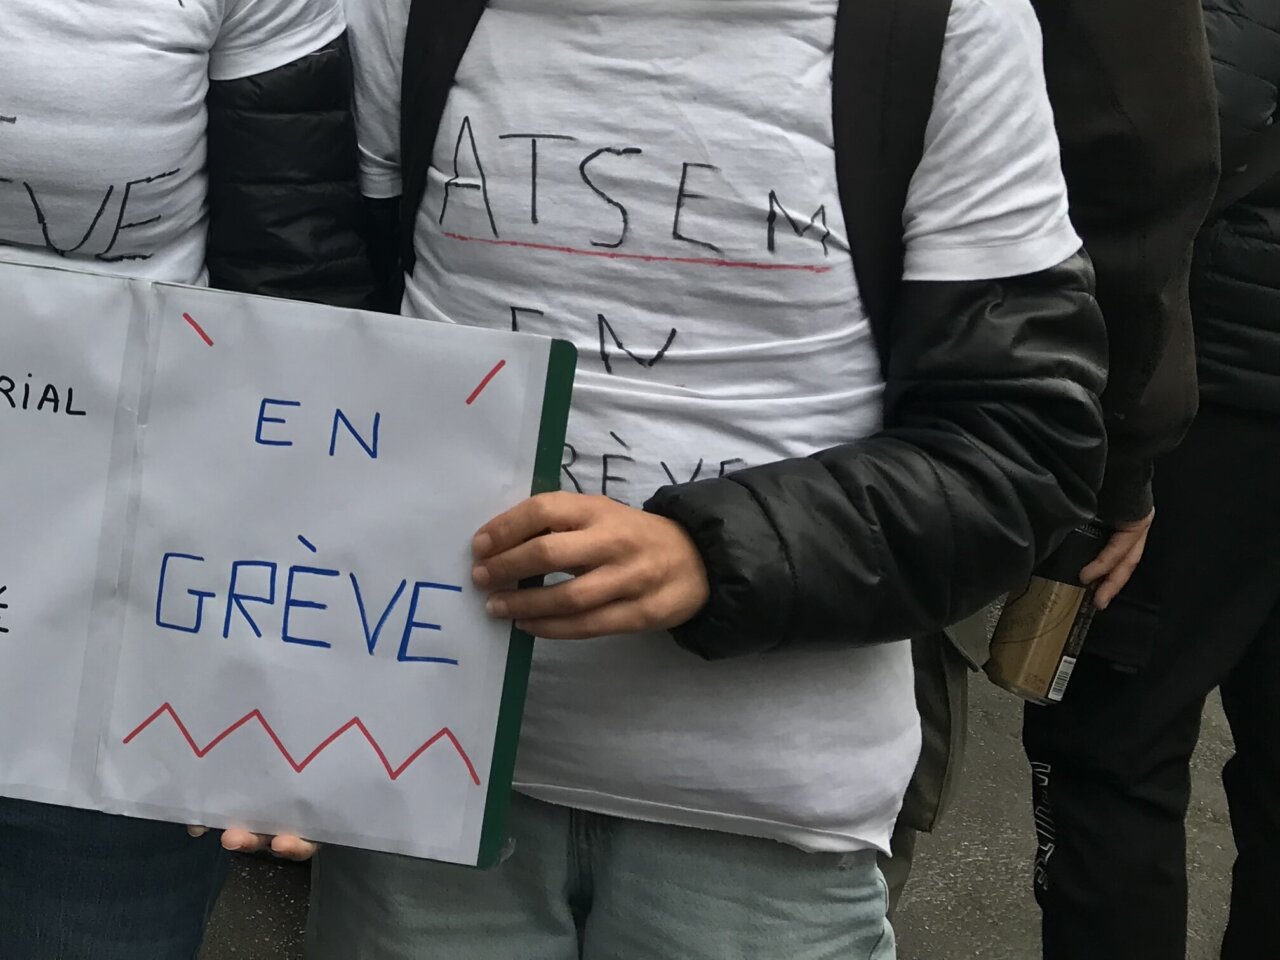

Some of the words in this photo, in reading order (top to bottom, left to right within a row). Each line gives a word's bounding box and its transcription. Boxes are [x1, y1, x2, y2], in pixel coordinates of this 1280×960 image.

[439, 116, 828, 256] ATSEM
[255, 398, 381, 459] EN
[156, 534, 463, 666] GRÈVE
